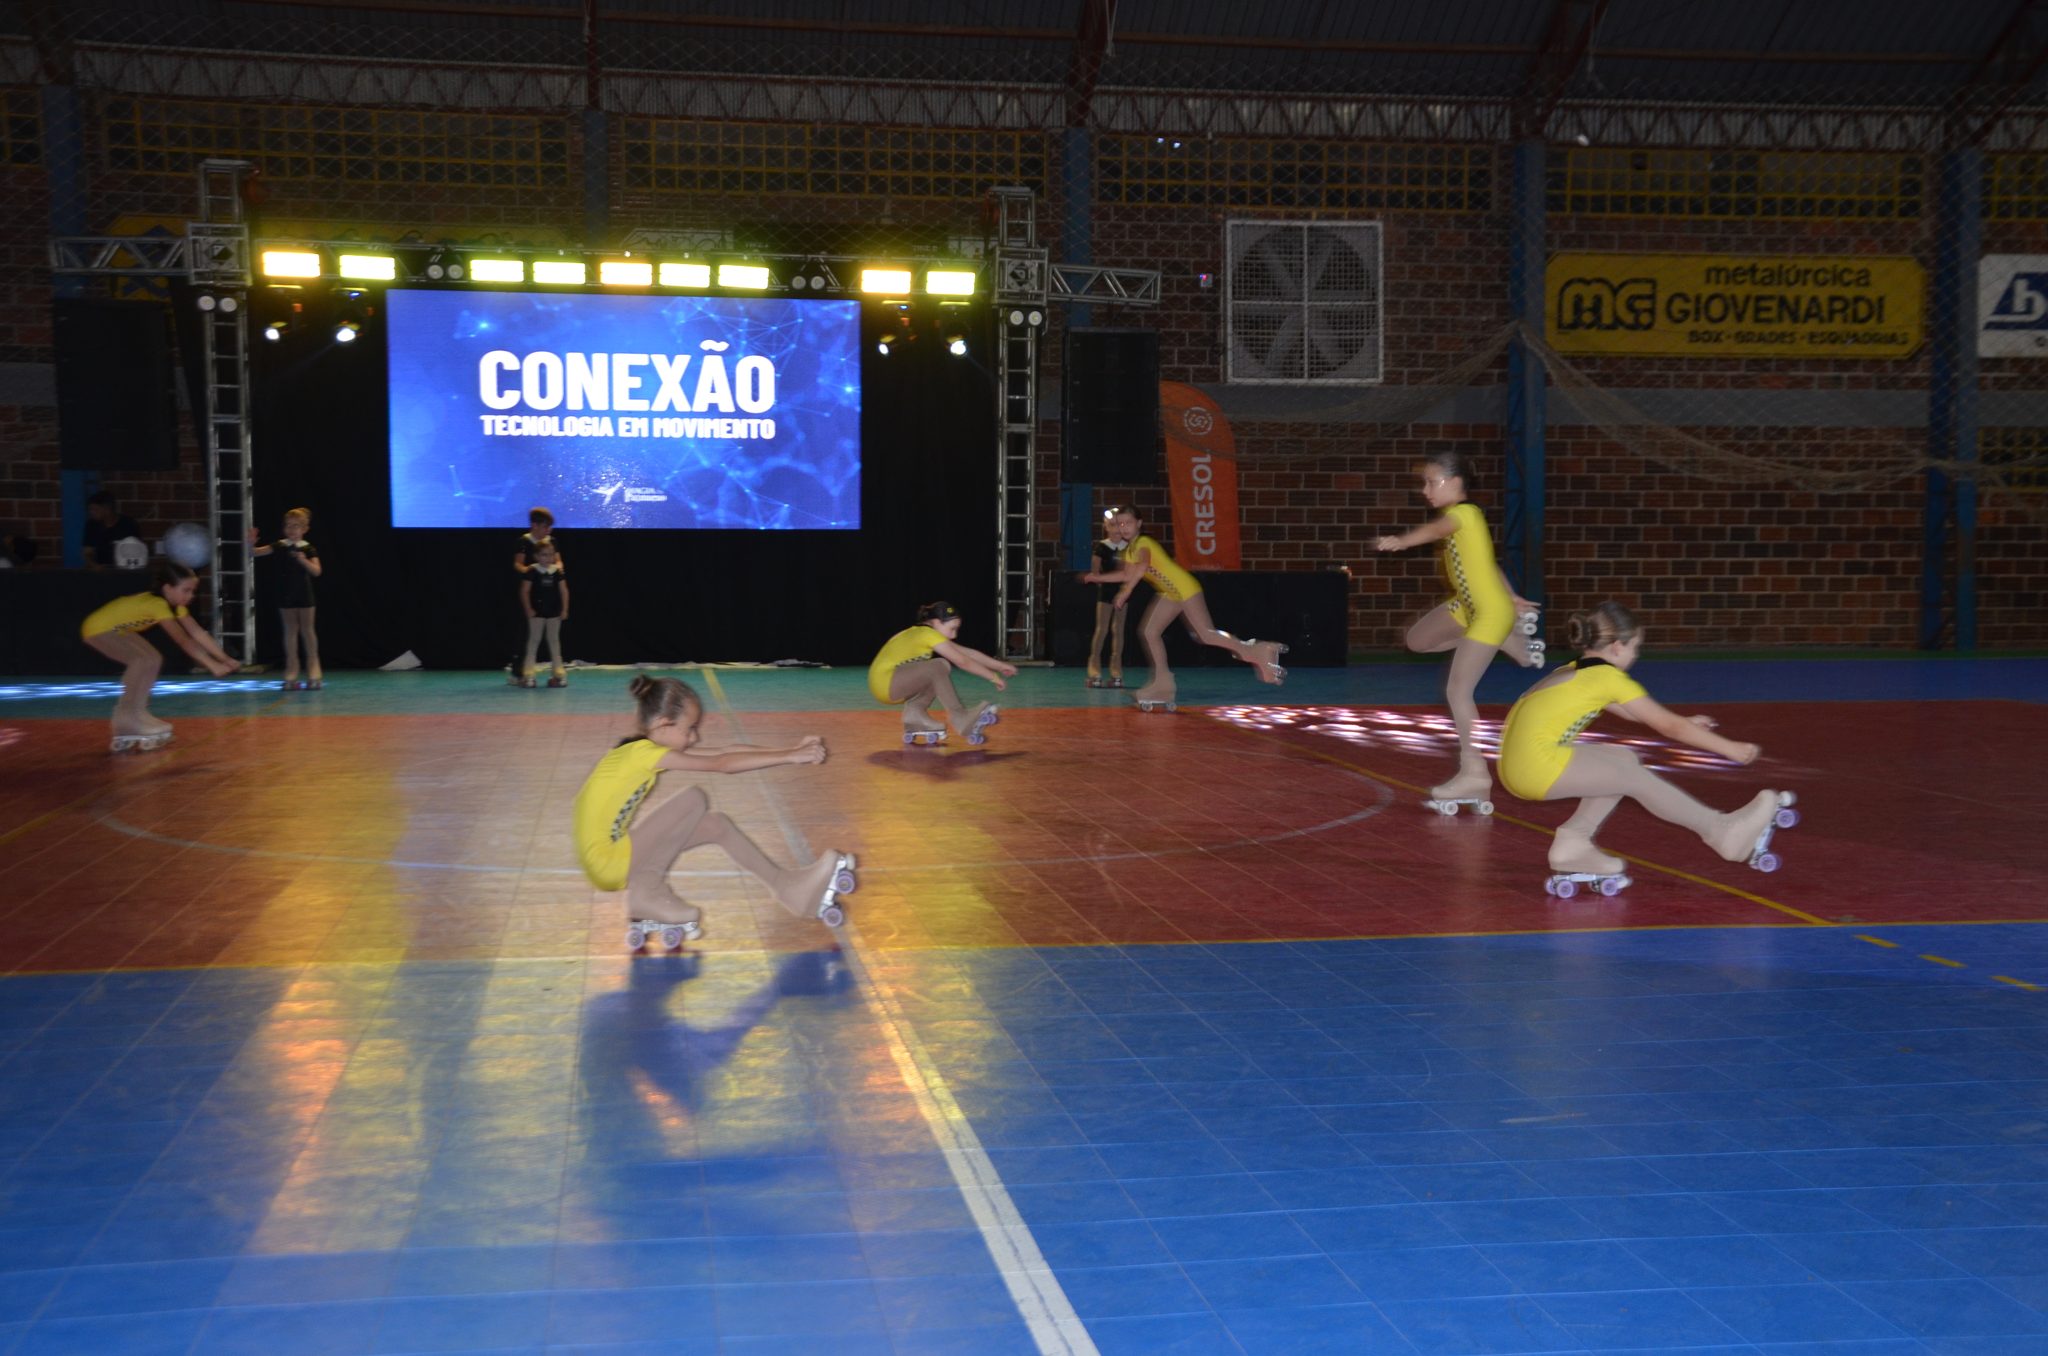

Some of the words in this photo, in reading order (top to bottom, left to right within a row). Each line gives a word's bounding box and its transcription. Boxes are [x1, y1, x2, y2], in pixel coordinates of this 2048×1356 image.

[1665, 292, 1886, 325] GIOVENARDI
[1687, 330, 1724, 344] BOX
[1733, 331, 1797, 345] GRADES
[479, 339, 776, 415] CONEXÃO
[480, 414, 614, 438] TECNOLOGIA
[618, 418, 649, 439] EM
[653, 418, 776, 440] MOVIMENTO
[1191, 449, 1217, 556] CRESOL
